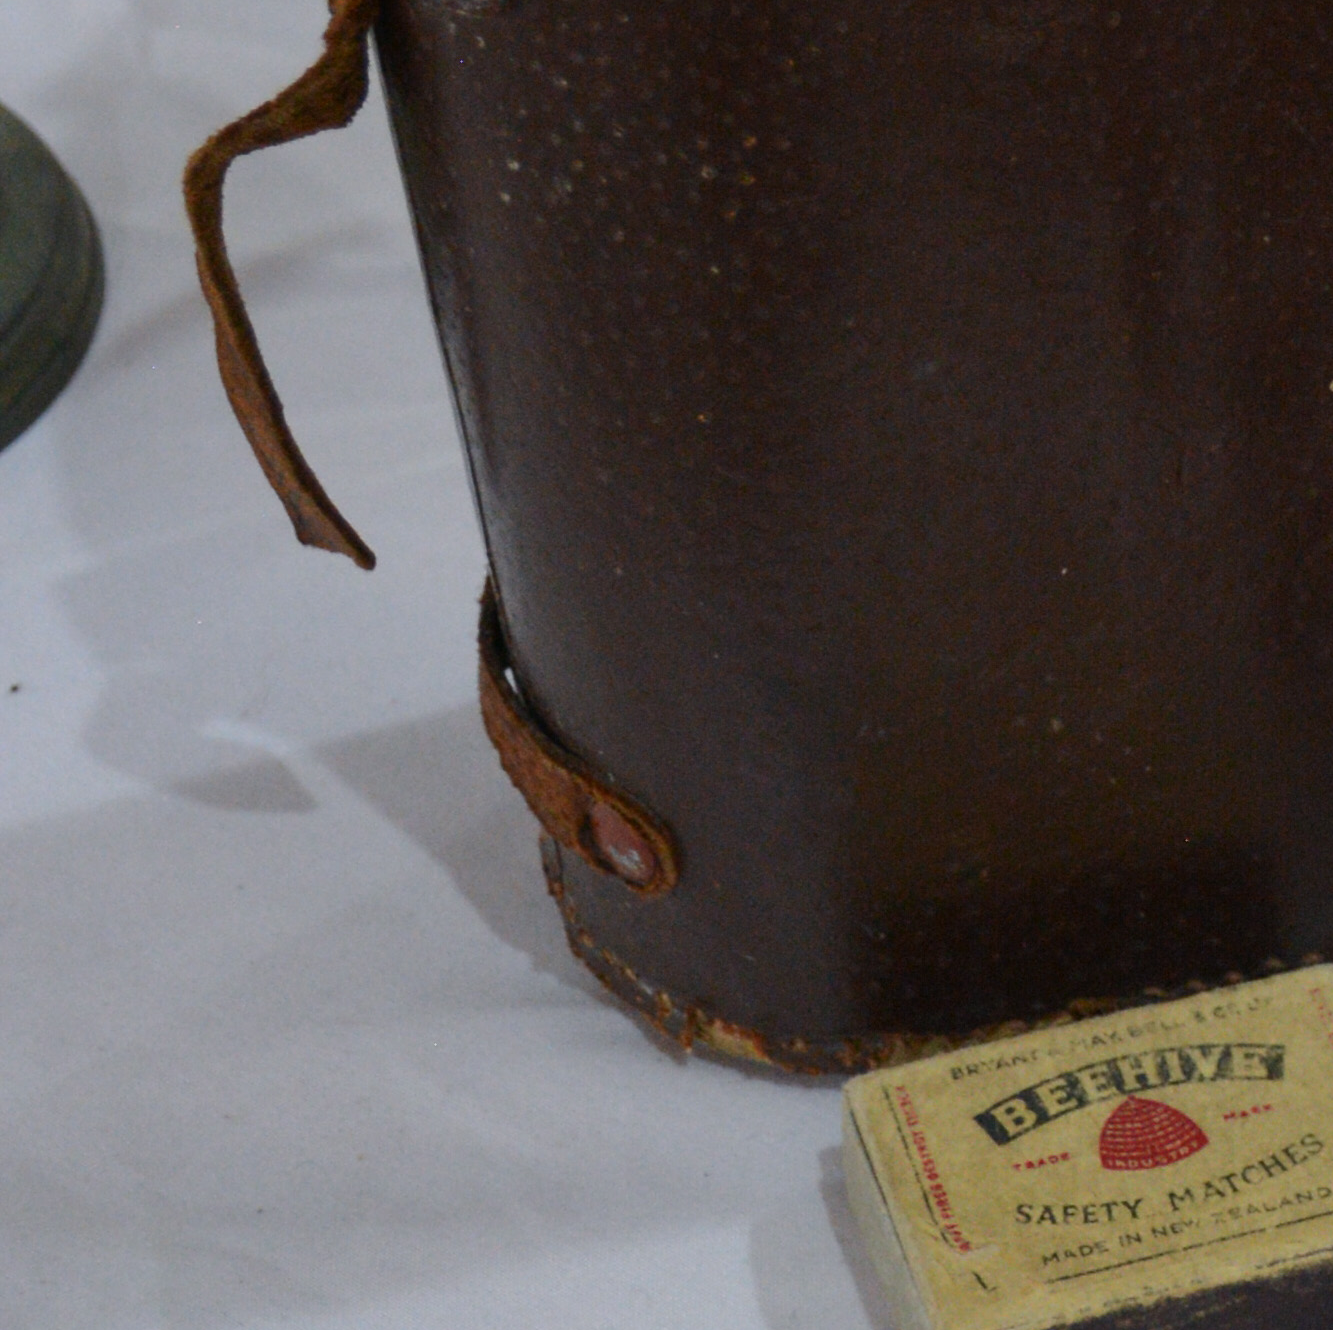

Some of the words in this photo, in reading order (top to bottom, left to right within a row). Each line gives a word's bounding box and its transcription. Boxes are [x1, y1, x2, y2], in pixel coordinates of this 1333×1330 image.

[952, 1050, 1040, 1081] BRYANT
[988, 1044, 1273, 1141] BEEHIVE
[1012, 1151, 1071, 1171] TRADE
[1223, 1103, 1274, 1121] MARK
[1105, 1139, 1203, 1168] INDUSTRY
[1016, 1197, 1144, 1226] SAFETY
[1167, 1132, 1325, 1213] MATCHES
[1042, 1239, 1111, 1266] MADE
[1119, 1231, 1143, 1248] IN
[1151, 1217, 1201, 1238] NEW
[1211, 1185, 1333, 1225] ZEALAND
